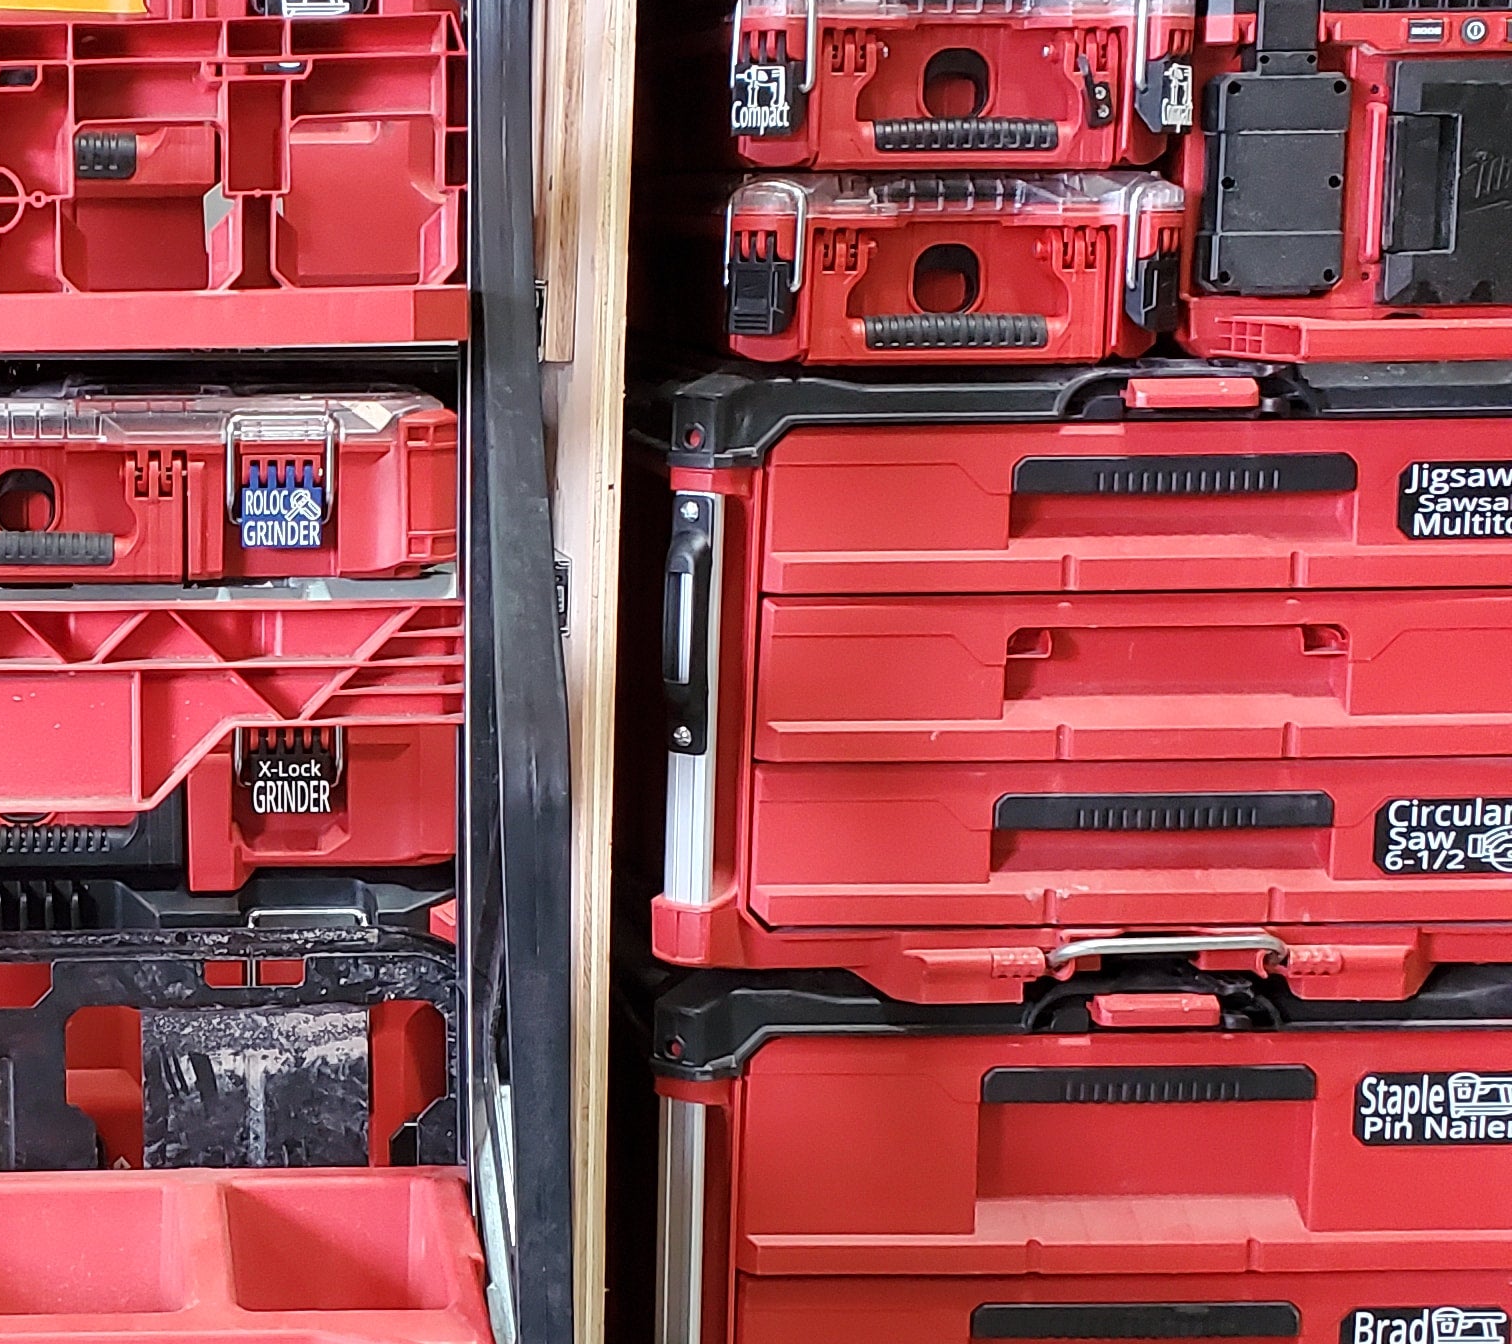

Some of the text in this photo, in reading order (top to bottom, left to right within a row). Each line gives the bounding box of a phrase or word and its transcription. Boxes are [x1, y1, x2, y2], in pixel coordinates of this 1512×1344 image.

[731, 101, 791, 136] Compact
[1404, 463, 1512, 495] Jigsaw
[246, 490, 289, 516] ROLOC
[244, 521, 321, 546] GRINDER
[258, 759, 322, 777] X-Lock
[253, 780, 331, 813] GRINDER
[1388, 827, 1456, 850] Saw
[1385, 849, 1465, 871] 6-1/2
[1360, 1074, 1445, 1124] Staple
[1364, 1116, 1413, 1140] Pin
